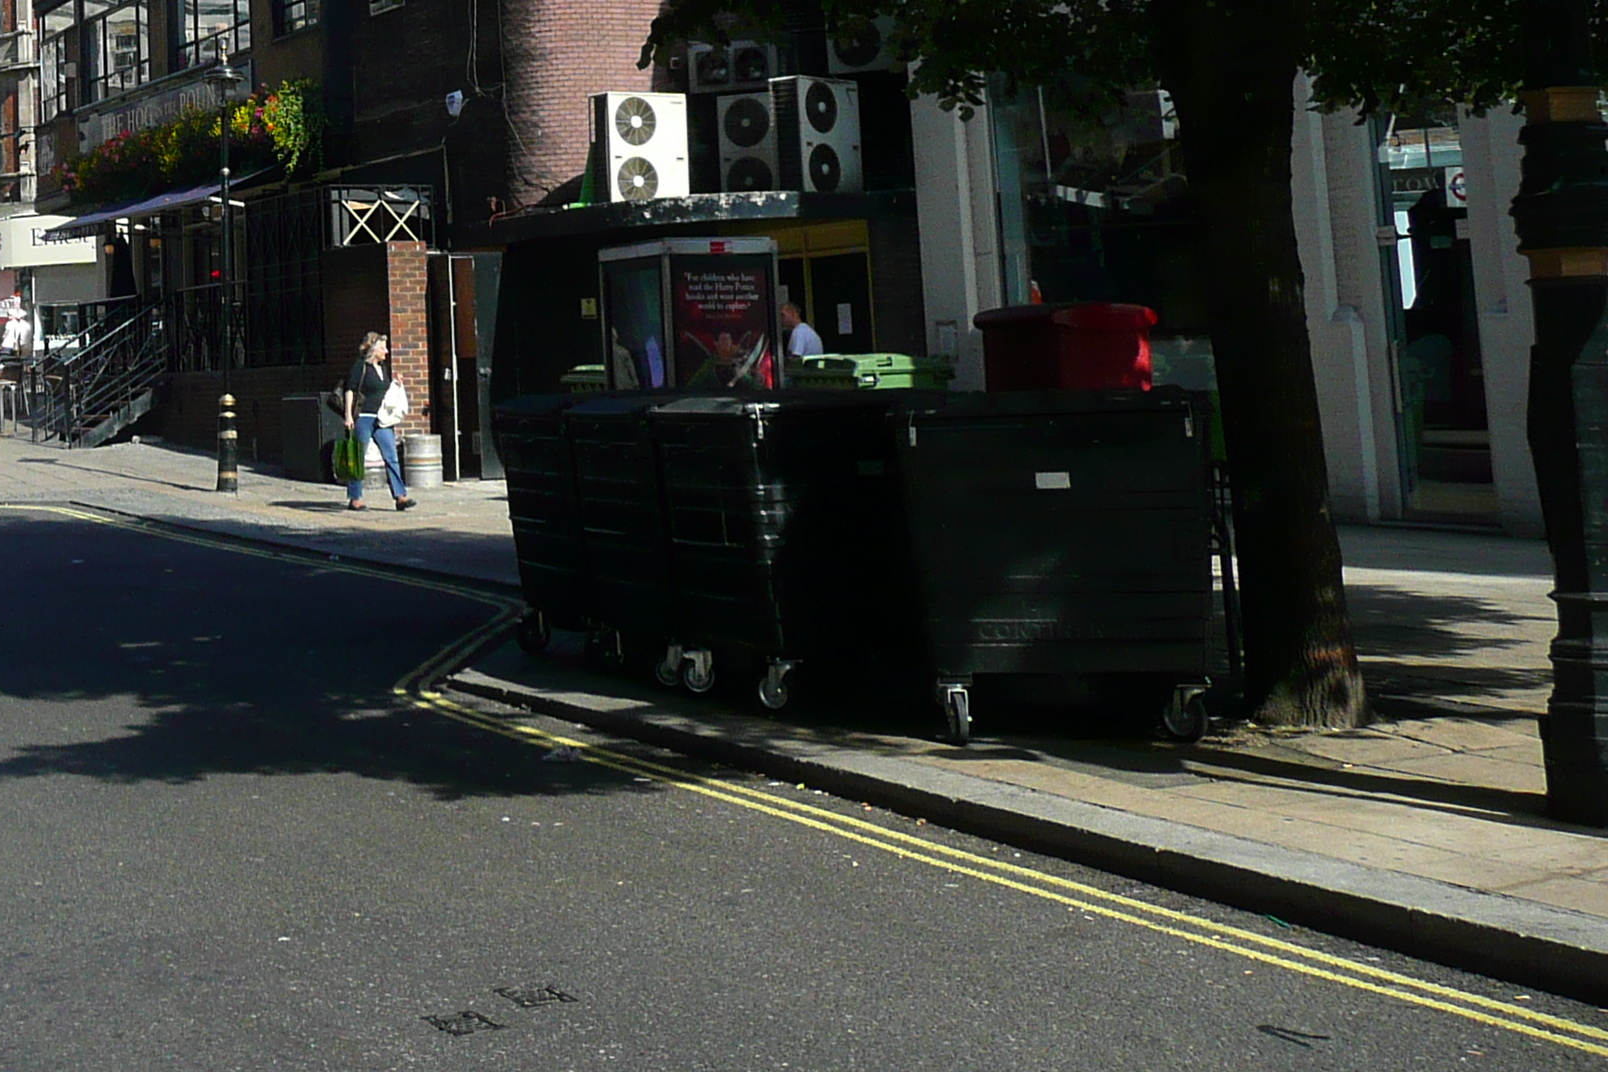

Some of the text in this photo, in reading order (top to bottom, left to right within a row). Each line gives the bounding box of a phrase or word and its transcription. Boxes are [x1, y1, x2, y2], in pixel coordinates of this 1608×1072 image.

[102, 113, 124, 140] THE
[127, 105, 154, 132] HOG
[180, 84, 225, 118] POUN
